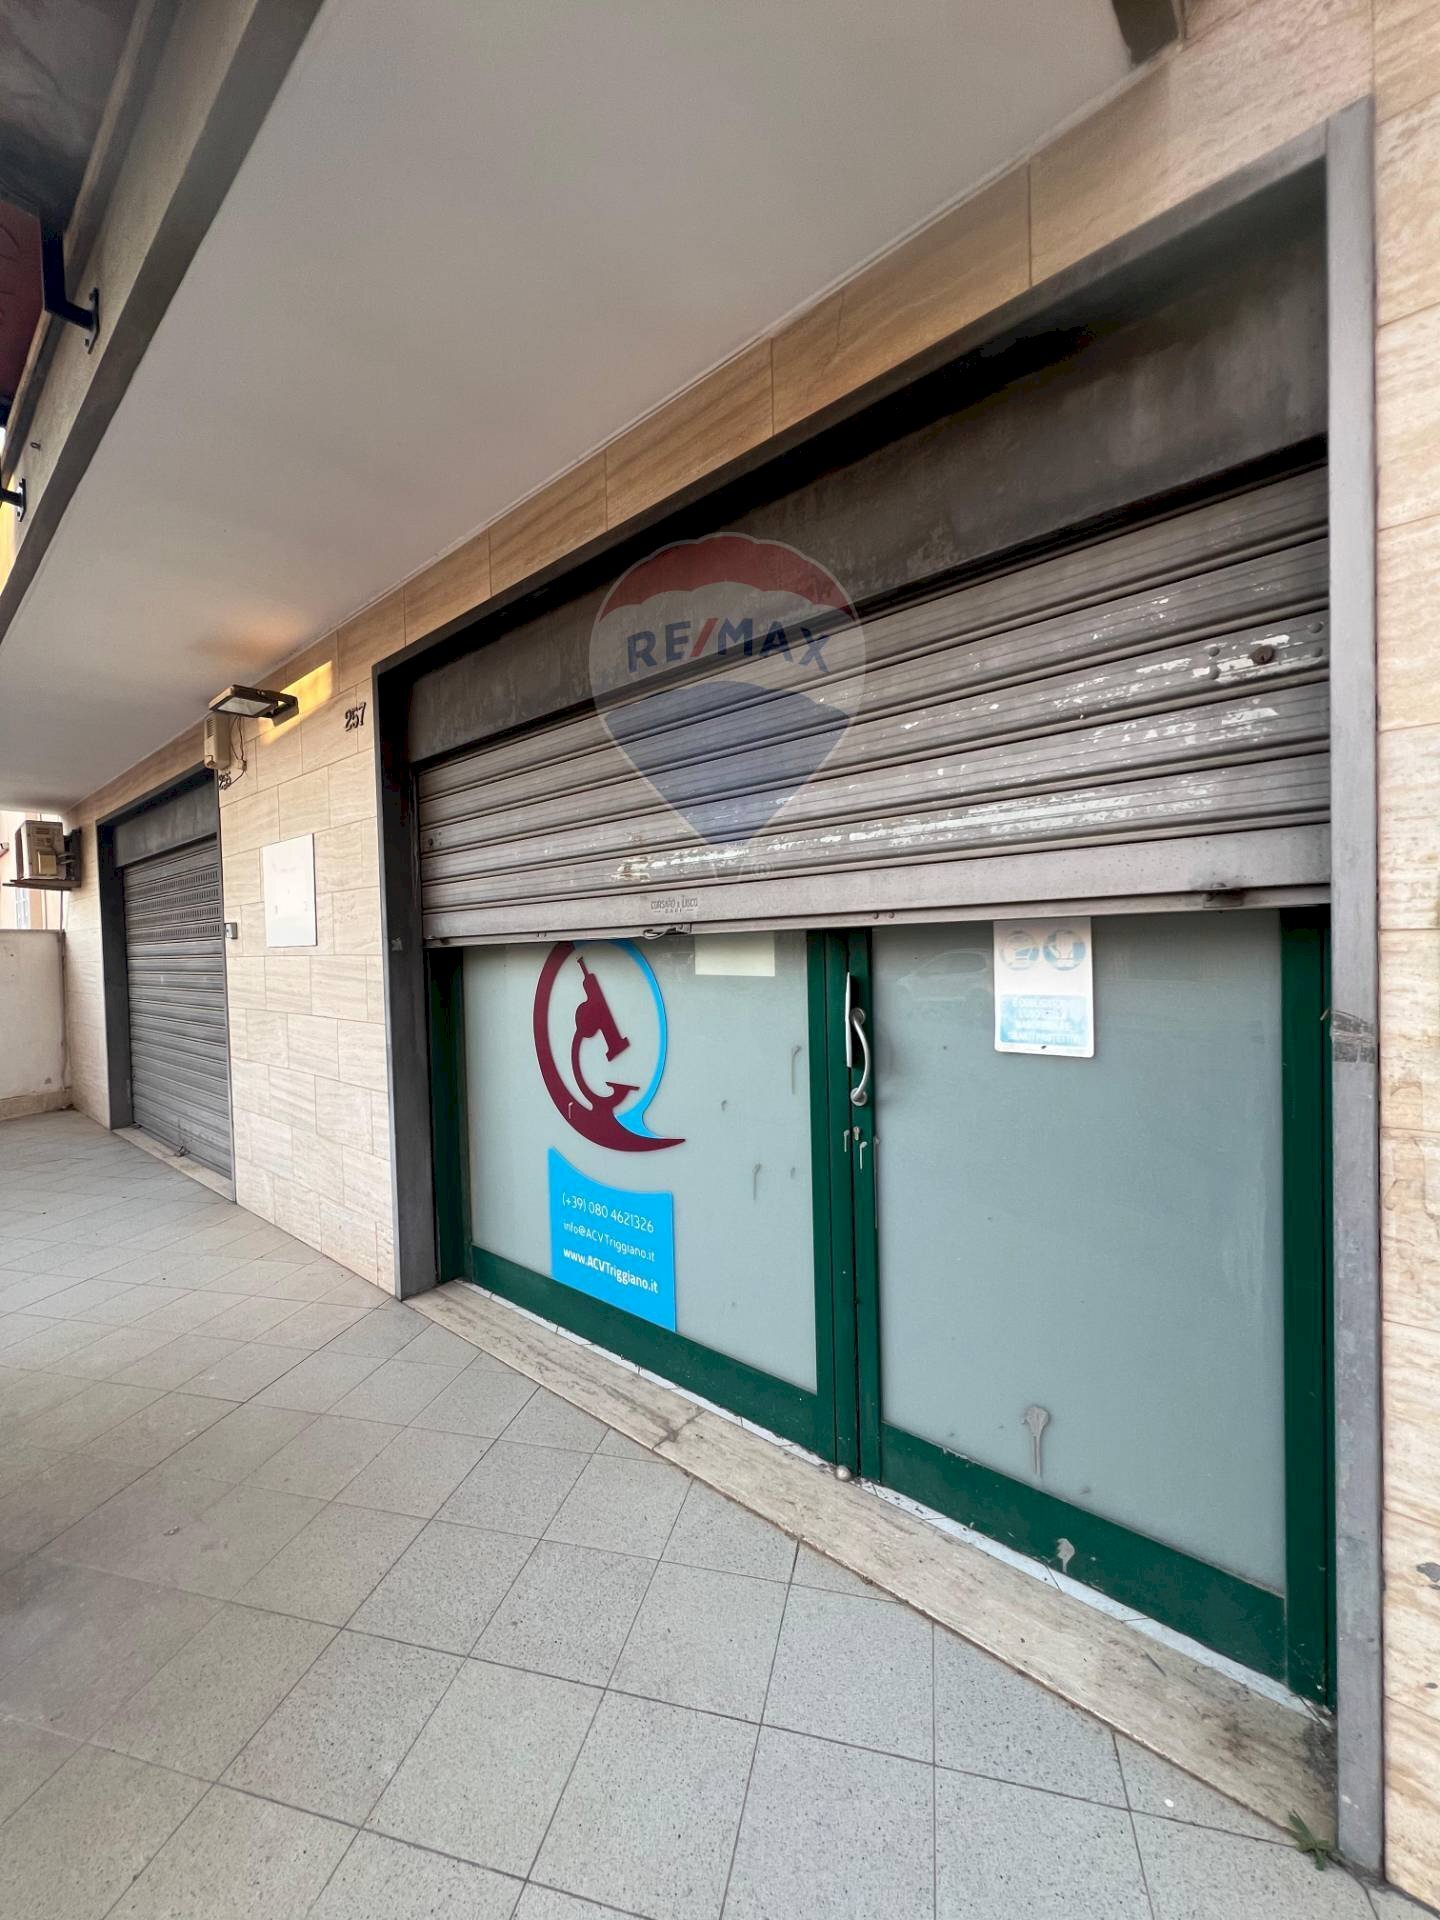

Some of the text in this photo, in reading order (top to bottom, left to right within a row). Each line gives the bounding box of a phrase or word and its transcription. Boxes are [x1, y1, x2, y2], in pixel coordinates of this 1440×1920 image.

[345, 702, 367, 732] 257
[562, 1191, 654, 1233] (+39) 080 4621326
[563, 1247, 659, 1294] www.ACVTriggiano.it
